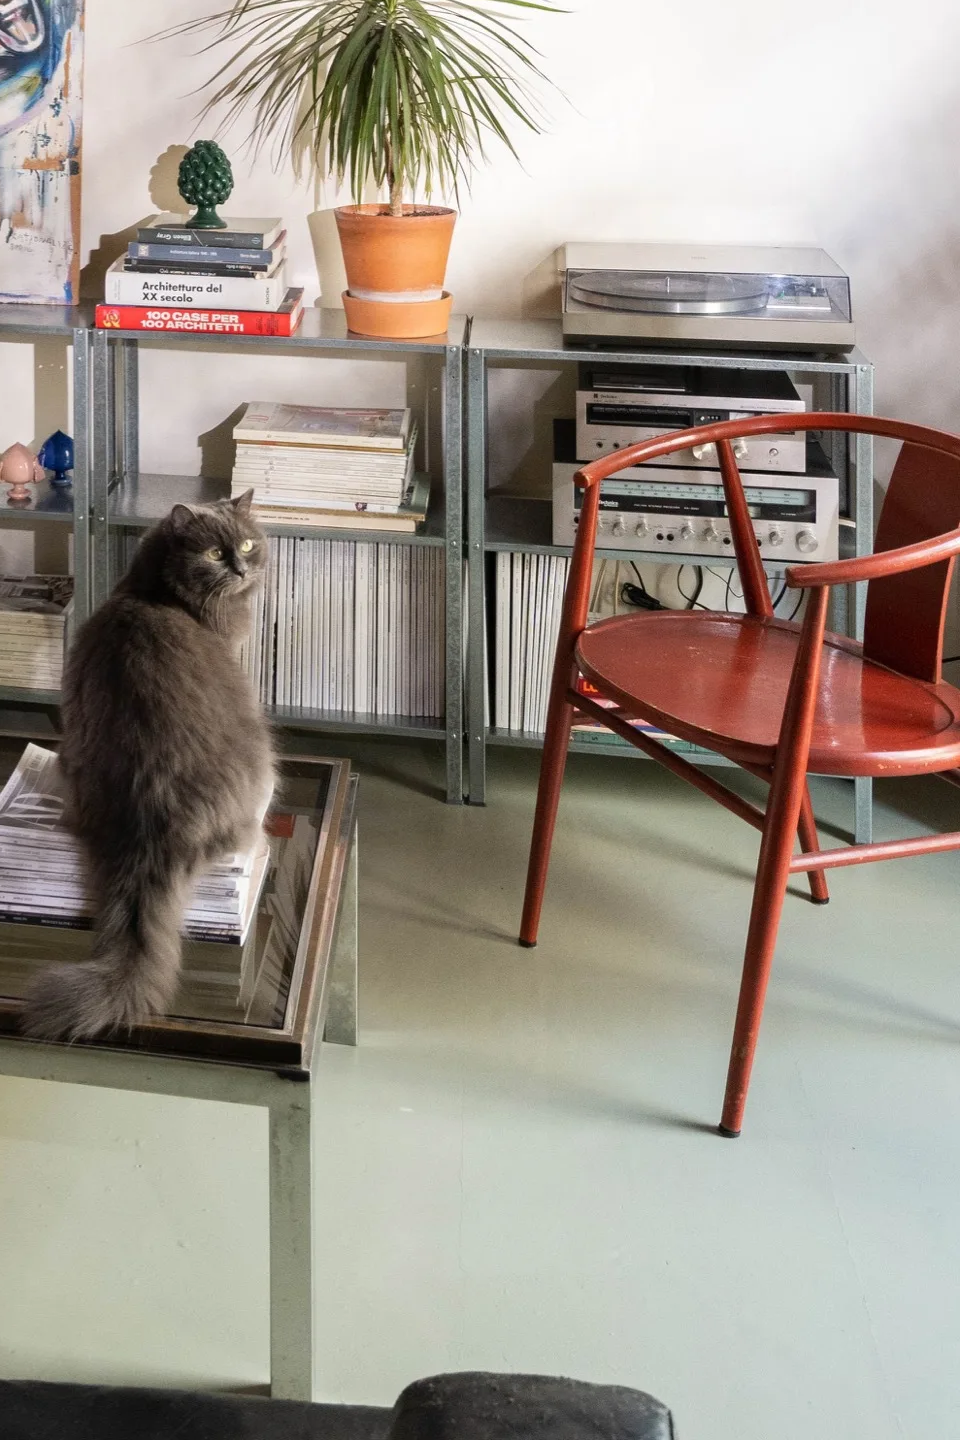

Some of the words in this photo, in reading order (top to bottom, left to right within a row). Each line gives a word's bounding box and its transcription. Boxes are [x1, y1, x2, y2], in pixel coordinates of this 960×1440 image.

[142, 281, 204, 293] Architettura
[206, 283, 222, 293] del
[142, 292, 158, 301] XX
[160, 293, 193, 303] secolo
[146, 311, 170, 321] 100
[172, 312, 209, 322] CASE
[211, 313, 239, 323] PER
[140, 319, 164, 329] 100
[166, 321, 244, 332] ARCHITETTI
